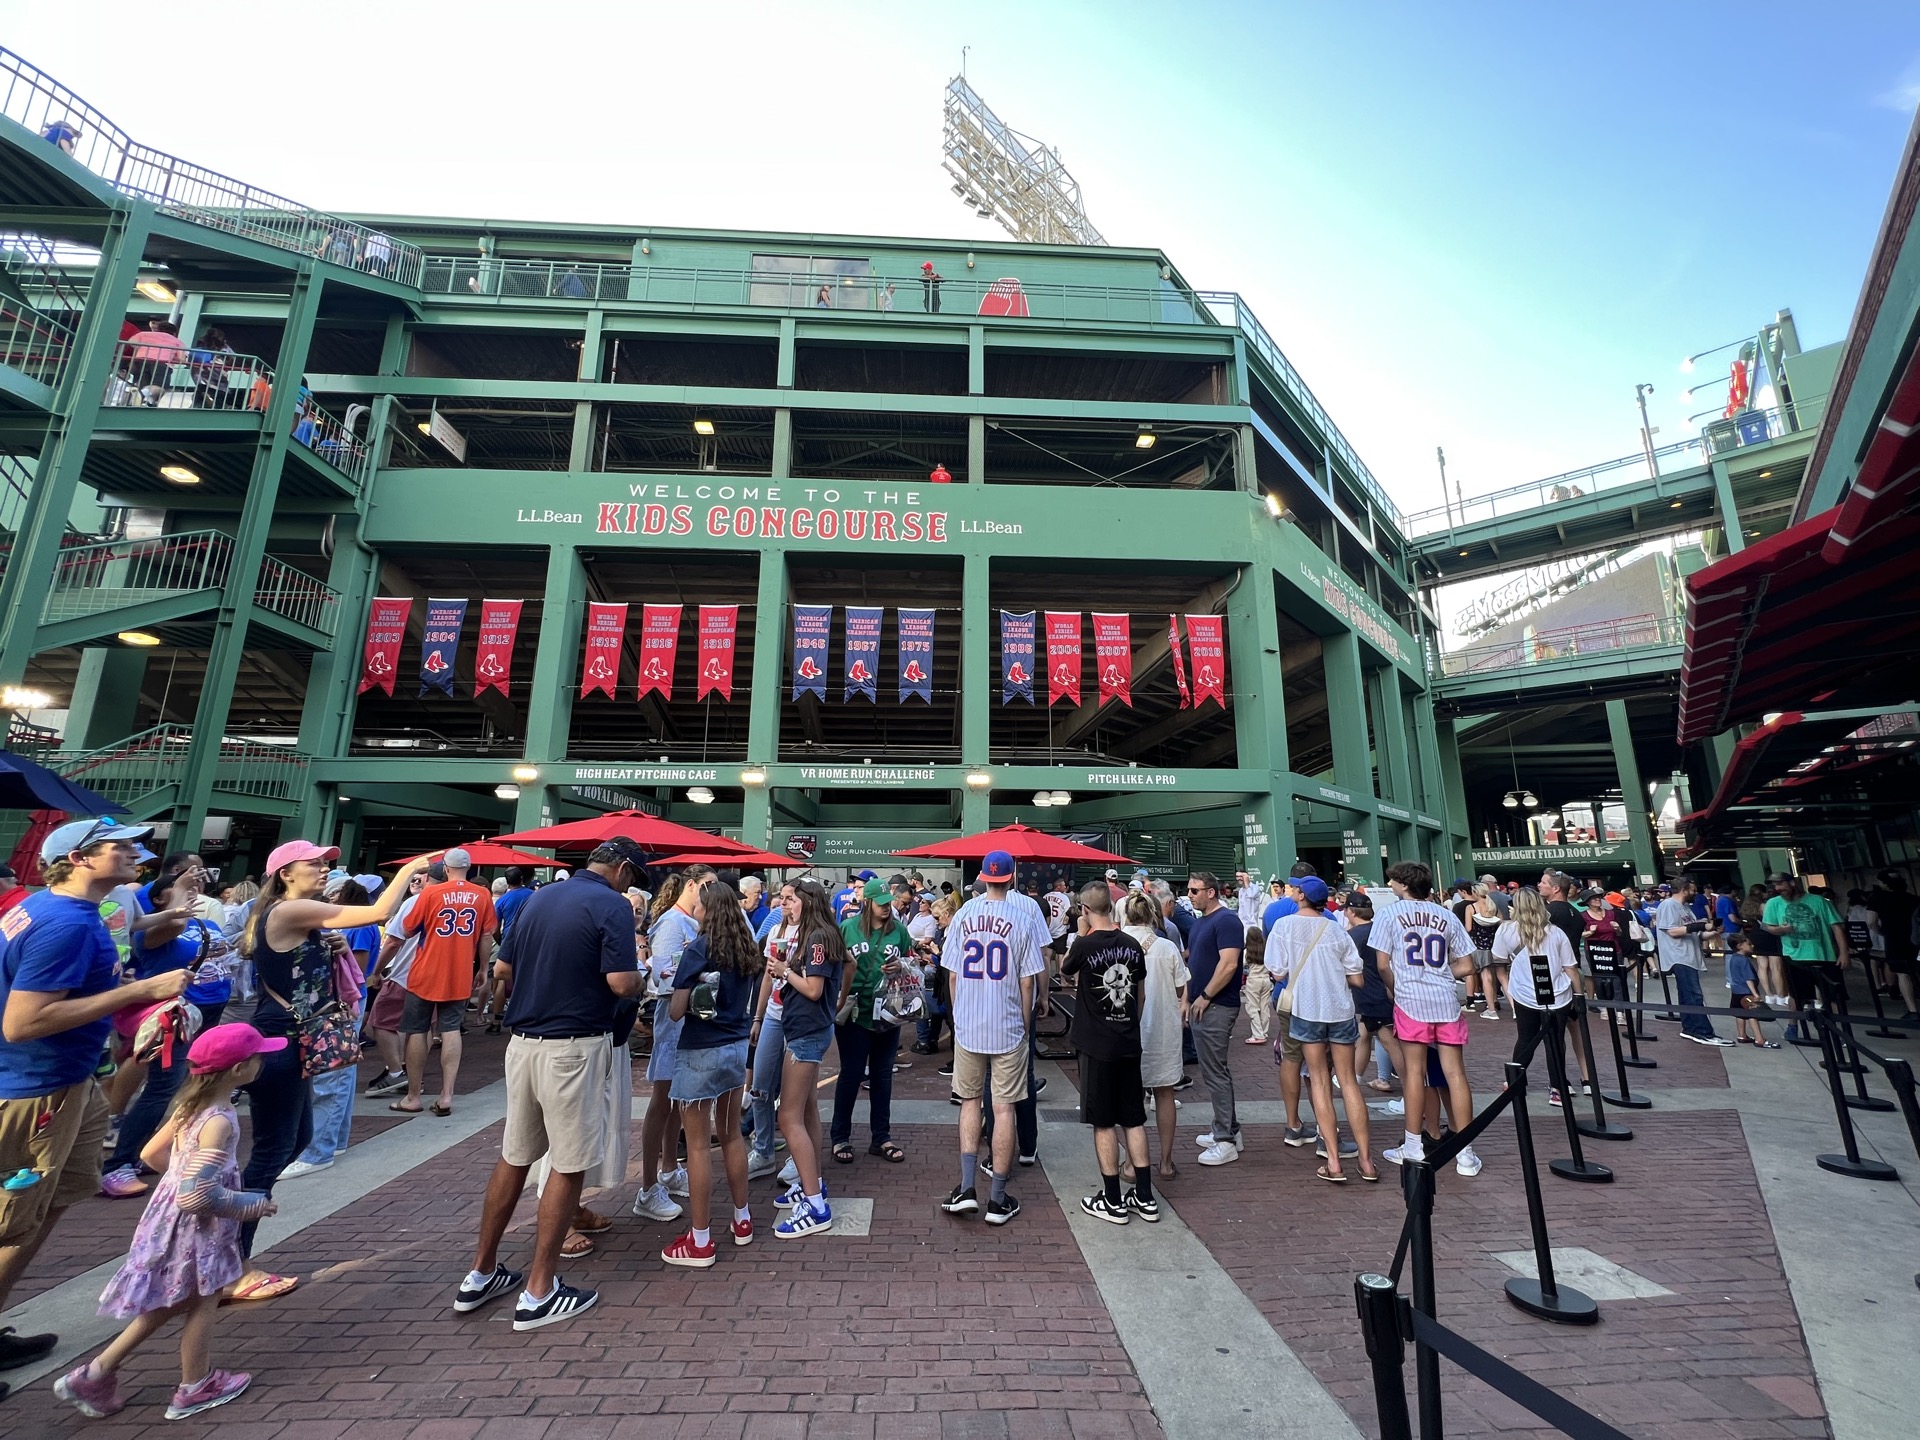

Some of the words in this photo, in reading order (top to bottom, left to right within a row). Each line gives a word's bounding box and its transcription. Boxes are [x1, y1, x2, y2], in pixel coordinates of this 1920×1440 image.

[629, 484, 781, 501] WELCOME
[804, 489, 840, 503] TO
[864, 491, 920, 505] THE
[516, 509, 583, 524] L.L.Bean
[596, 502, 694, 535] KIDS
[706, 505, 948, 543] CONCOURSE
[960, 520, 1023, 534] L.L.Bean
[1327, 565, 1365, 607] WELCOME
[1367, 604, 1377, 618] TO
[1379, 614, 1392, 633] THE
[1322, 575, 1349, 618] KIDS
[1349, 600, 1399, 661] CONCOURSE
[425, 632, 456, 642] 1904
[482, 635, 510, 645] 1912
[591, 637, 618, 648] 1915
[646, 638, 673, 649] 1916
[796, 638, 825, 649] 1946
[848, 641, 877, 651] 1967
[901, 641, 930, 652] 1975
[1050, 645, 1080, 655] 2004
[1098, 646, 1128, 656] 2007
[576, 768, 602, 779] HIGH
[604, 769, 633, 779] HEAT
[634, 769, 686, 779] PITCHING
[688, 770, 717, 780] CAGE
[801, 768, 816, 778] VR
[818, 769, 848, 779] HOME
[850, 769, 872, 779] RUN
[874, 769, 935, 779] CHALLENGE
[1088, 774, 1119, 784] PITCH
[1121, 774, 1143, 784] LIKE
[1145, 775, 1153, 784] A
[1155, 775, 1176, 785] PRO
[584, 786, 612, 803] ROYAL
[1244, 814, 1255, 823] HOW
[1245, 824, 1252, 834] DO
[1253, 824, 1263, 833] YOU
[1343, 830, 1355, 838] HOW
[1246, 834, 1268, 845] MEASURE
[1344, 839, 1351, 847] DO
[1352, 838, 1363, 846] YOU
[1247, 846, 1257, 856] UP?
[1345, 847, 1369, 855] MEASURE
[1472, 851, 1502, 861] DSTAND
[1510, 850, 1537, 860] RIGHT
[1538, 849, 1565, 859] FIELD
[1566, 848, 1591, 857] ROOF
[1346, 856, 1356, 864] UP?
[443, 892, 479, 905] HARVEY
[1052, 905, 1059, 918] 5
[435, 907, 477, 937] 33
[960, 915, 1013, 938] ALONSO
[1397, 912, 1448, 932] ALONSO
[811, 944, 825, 966] B
[1404, 932, 1446, 968] 20
[962, 939, 1009, 980] 20
